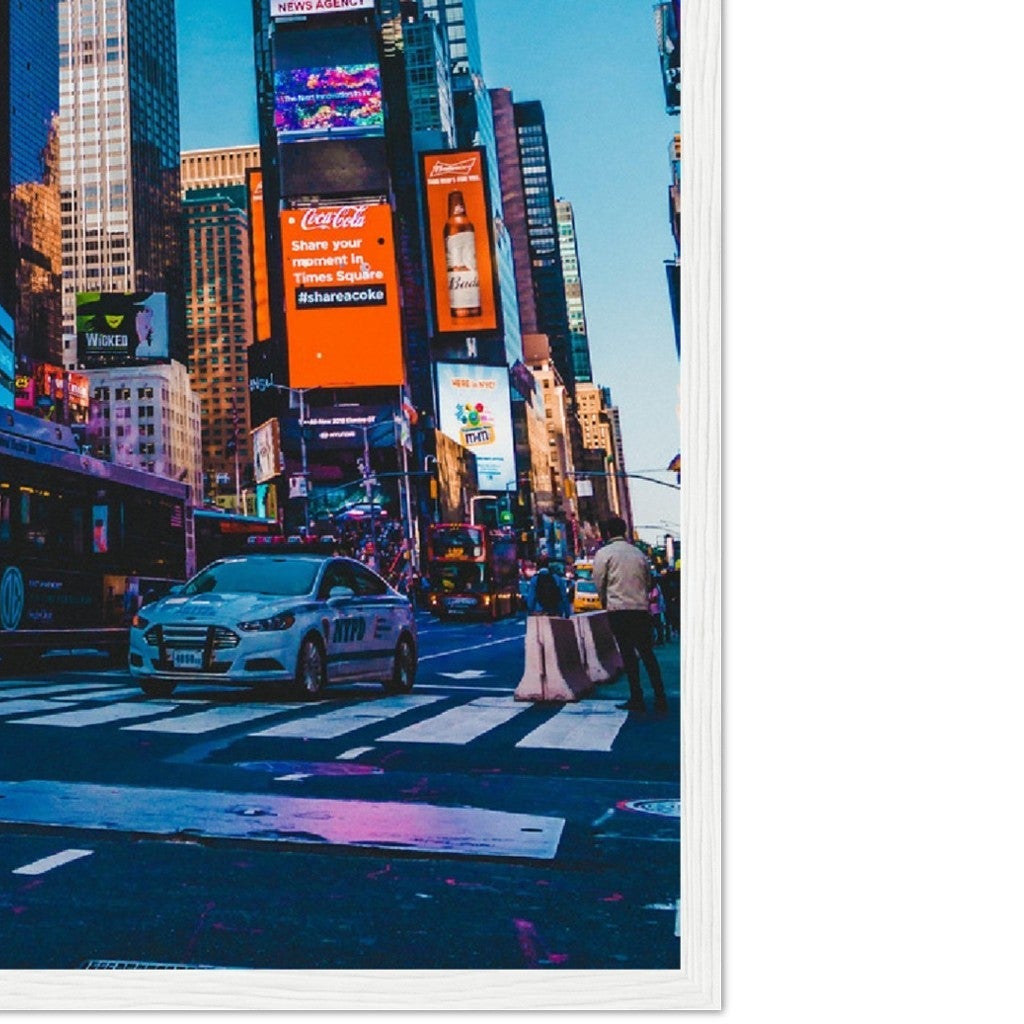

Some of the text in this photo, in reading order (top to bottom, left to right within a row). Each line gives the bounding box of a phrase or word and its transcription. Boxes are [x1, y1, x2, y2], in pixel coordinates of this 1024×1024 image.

[278, 1, 313, 13] NEWS
[300, 205, 367, 231] Coca-Cola
[291, 238, 362, 252] Share your
[292, 255, 348, 267] moment
[294, 270, 384, 284] Times Square
[298, 288, 384, 304] #shareacoke
